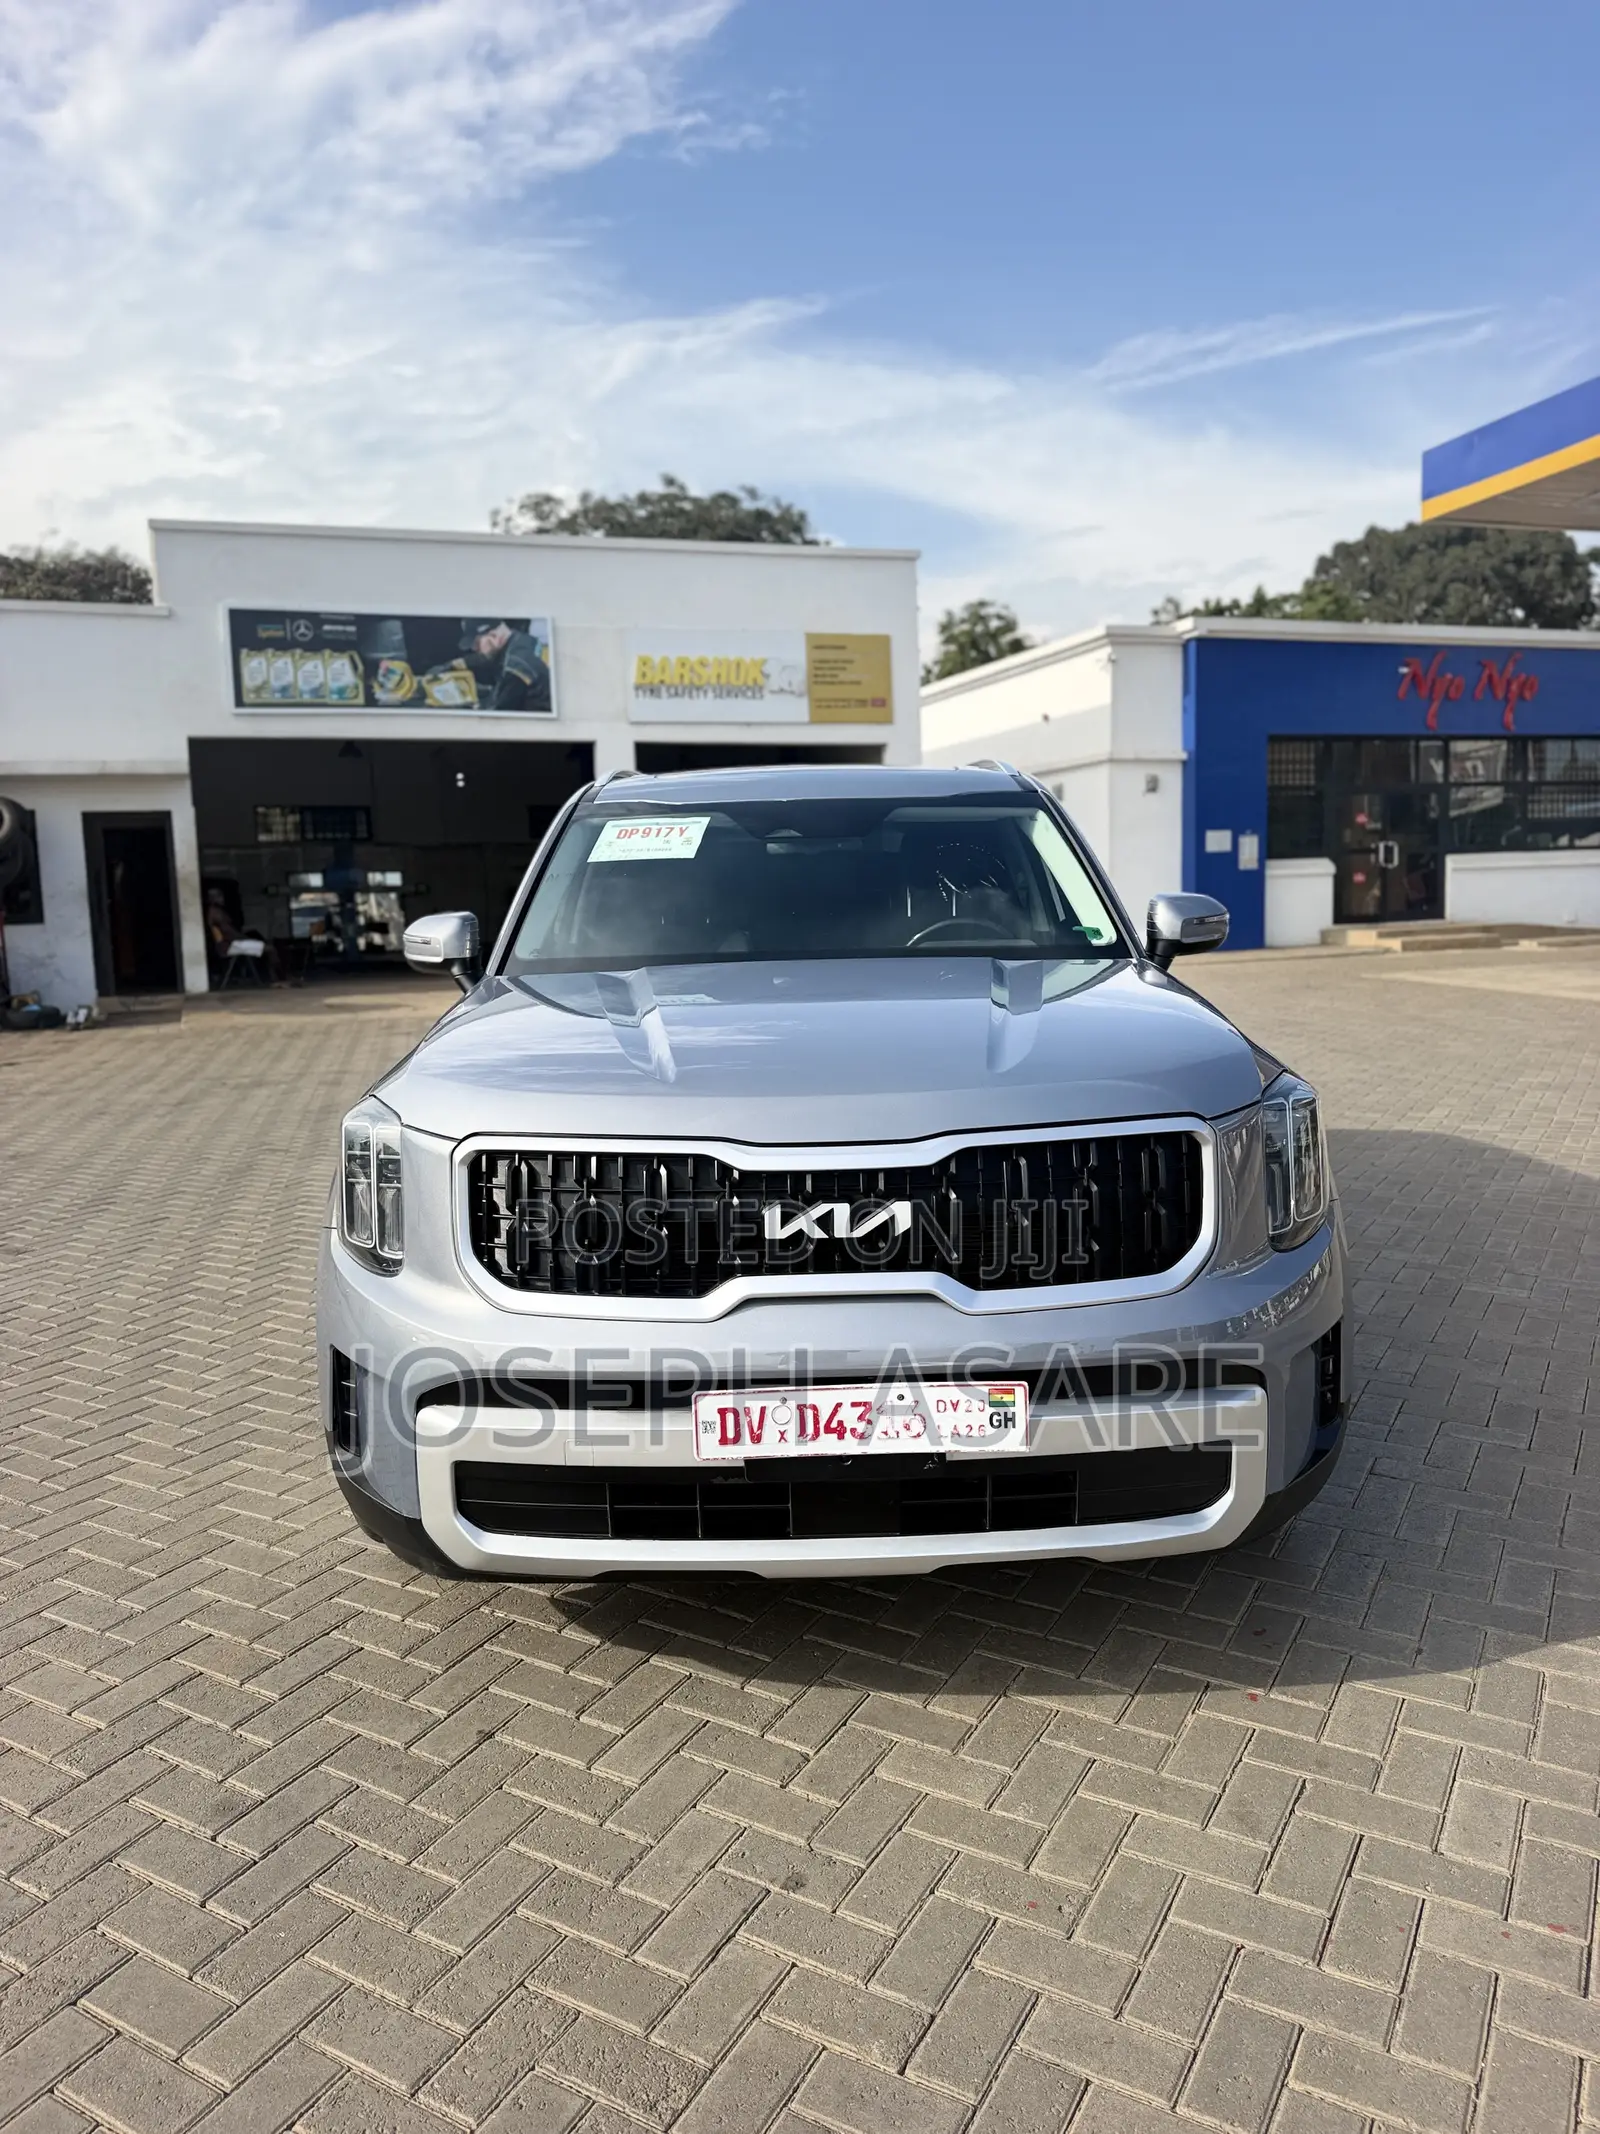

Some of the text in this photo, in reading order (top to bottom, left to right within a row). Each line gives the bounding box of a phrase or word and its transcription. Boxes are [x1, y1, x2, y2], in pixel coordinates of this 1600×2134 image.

[666, 686, 709, 700] SAFETY
[717, 1405, 767, 1445] DV
[989, 1411, 1016, 1429] GH
